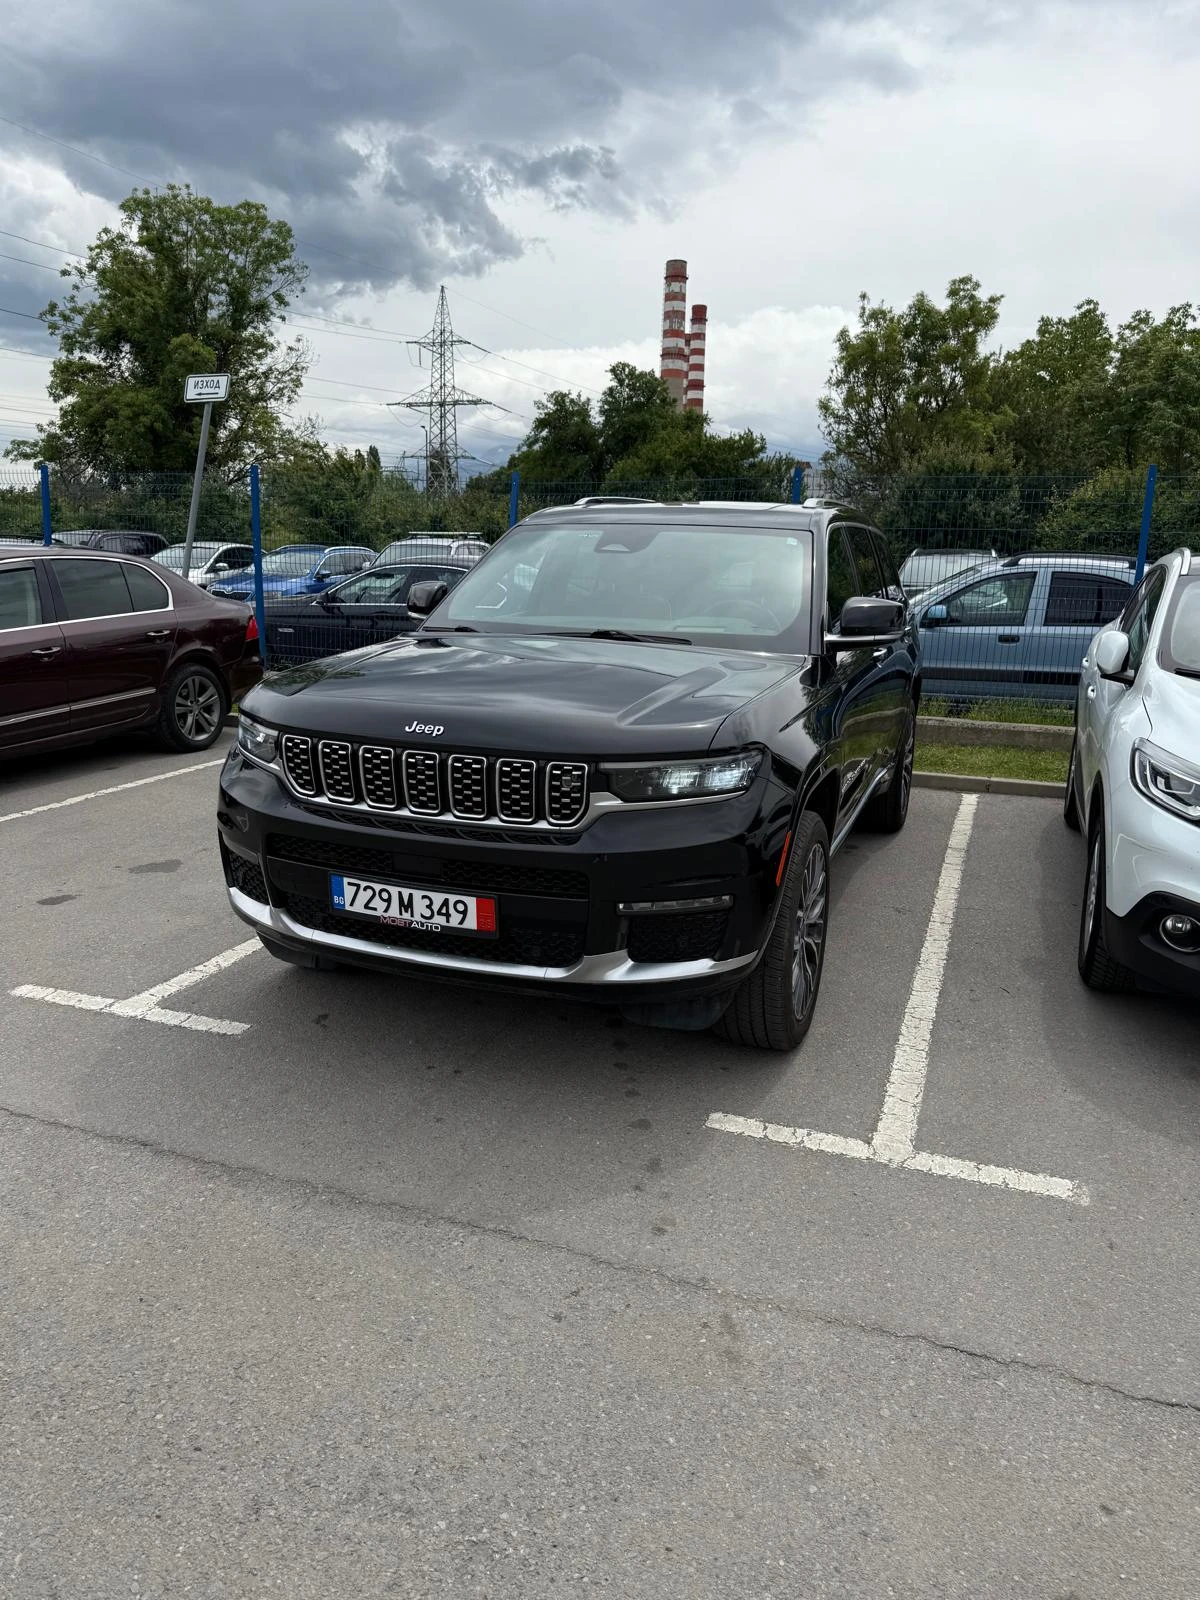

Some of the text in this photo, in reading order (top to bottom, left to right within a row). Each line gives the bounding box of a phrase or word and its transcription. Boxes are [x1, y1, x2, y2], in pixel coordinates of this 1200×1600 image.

[193, 379, 221, 390] ИЗХОД
[404, 720, 445, 737] Jeep
[333, 895, 345, 905] BG
